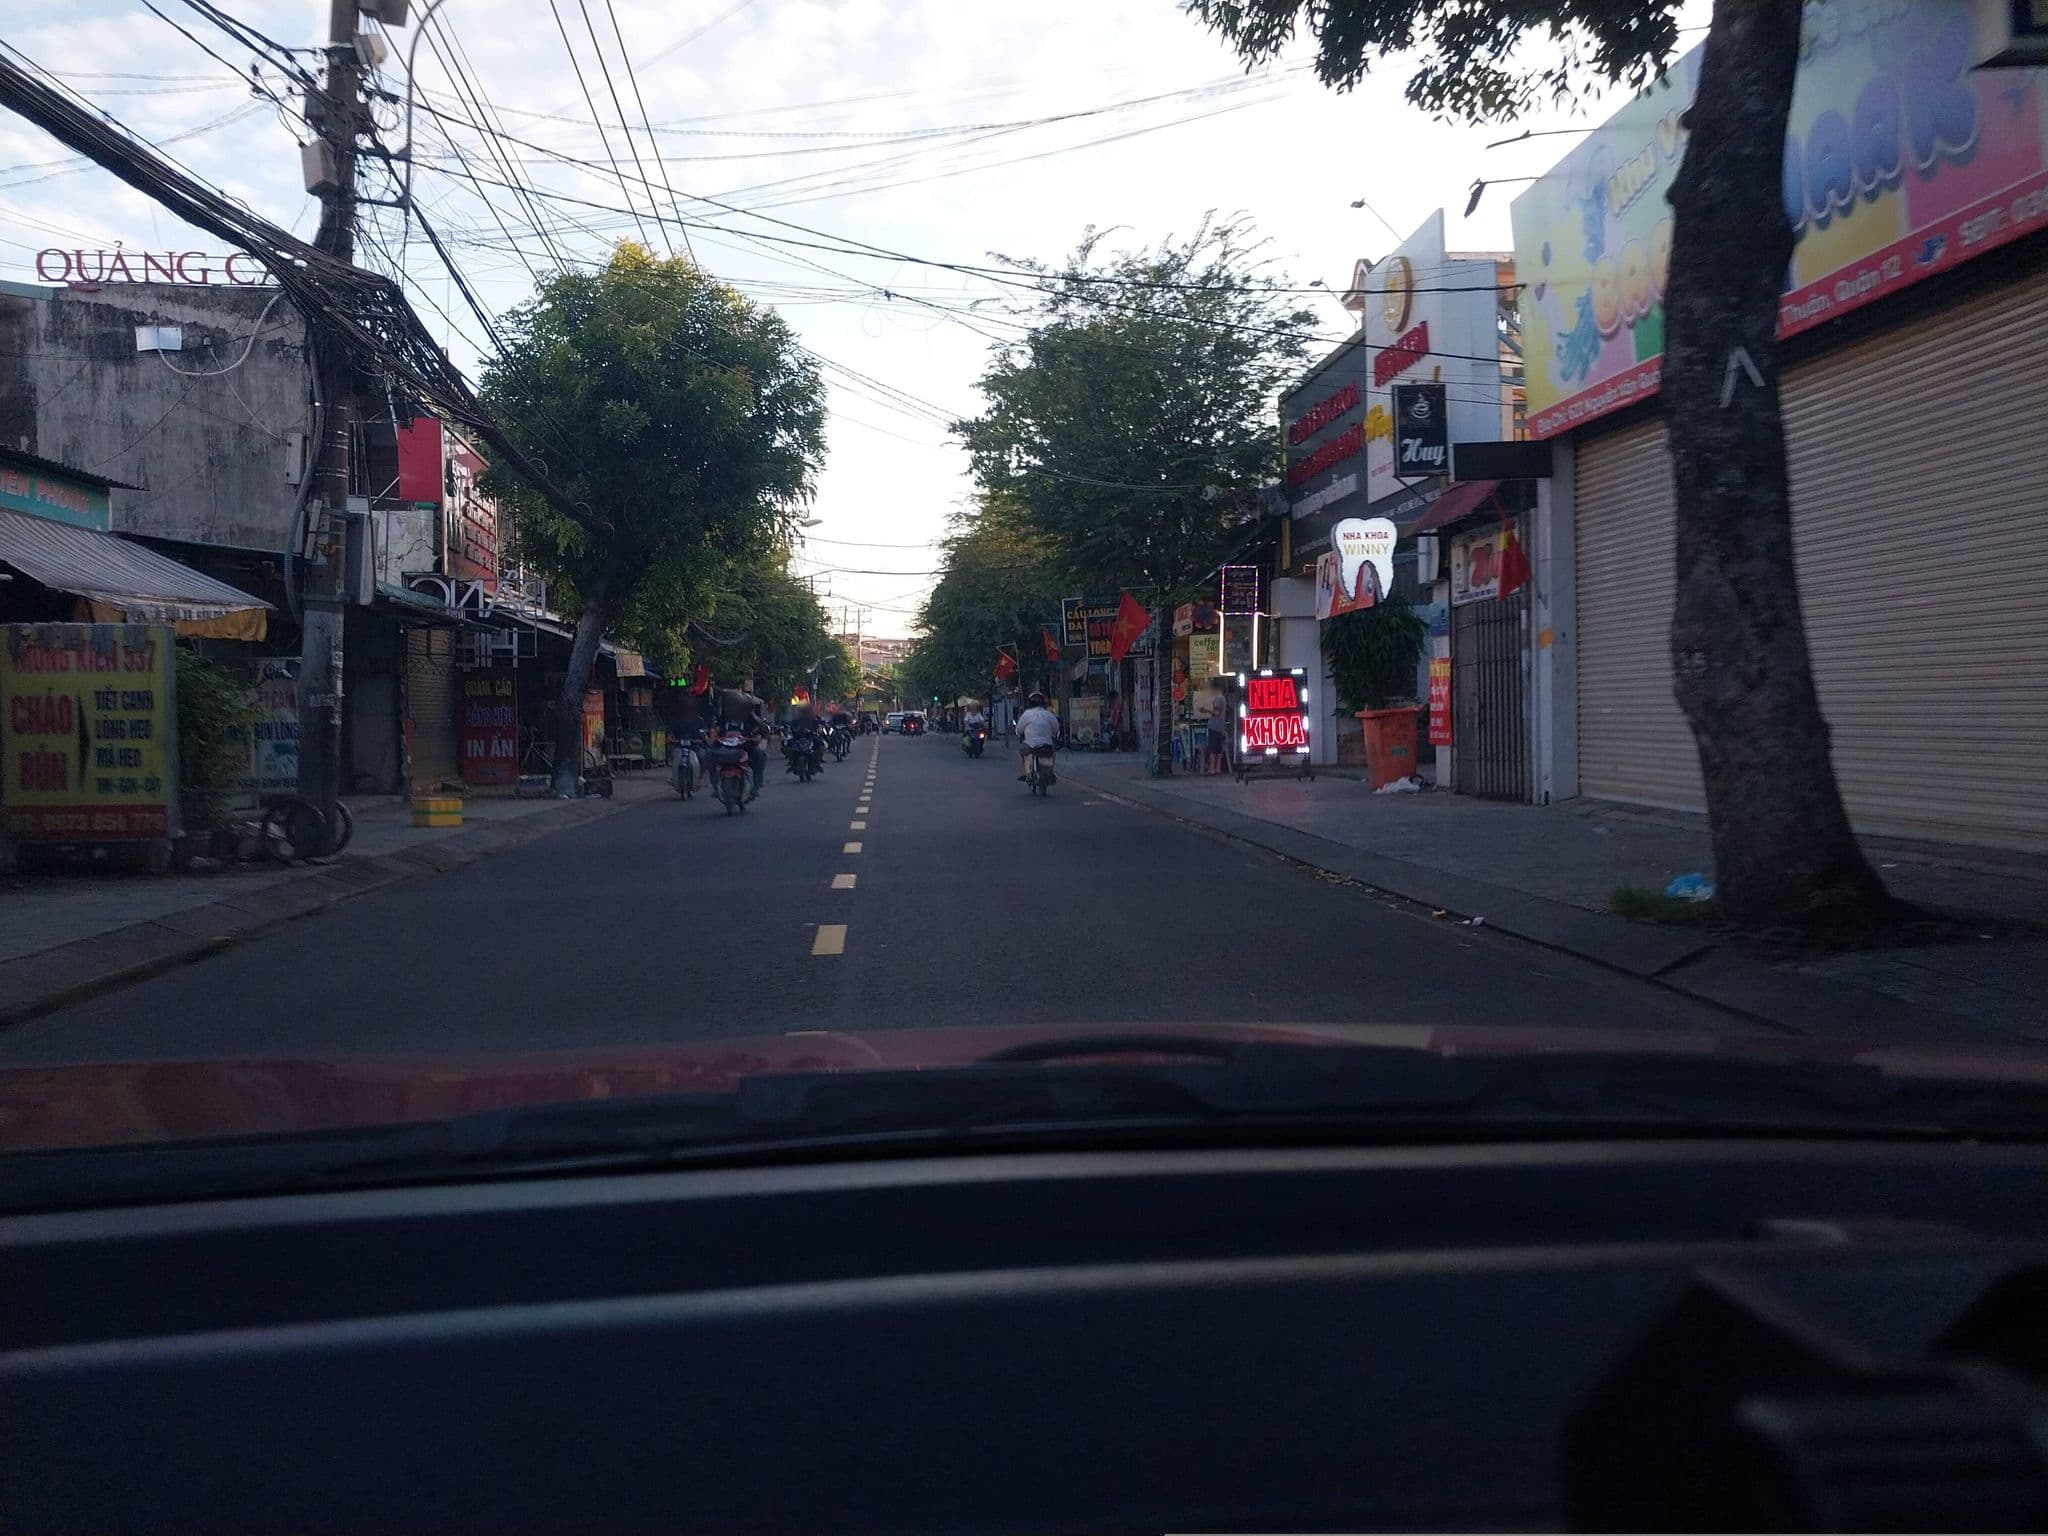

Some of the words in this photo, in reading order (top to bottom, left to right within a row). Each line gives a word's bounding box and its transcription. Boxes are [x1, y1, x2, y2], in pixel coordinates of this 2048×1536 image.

[36, 240, 211, 292] QUẢNG
[1834, 269, 1881, 303] Quận
[1343, 531, 1361, 541] NHA
[1365, 531, 1389, 541] KHOA
[1343, 543, 1390, 556] WINNY
[1247, 679, 1297, 710] NHA
[11, 687, 73, 735] CHÁO
[1244, 715, 1305, 747] KHOA
[467, 738, 485, 758] IN
